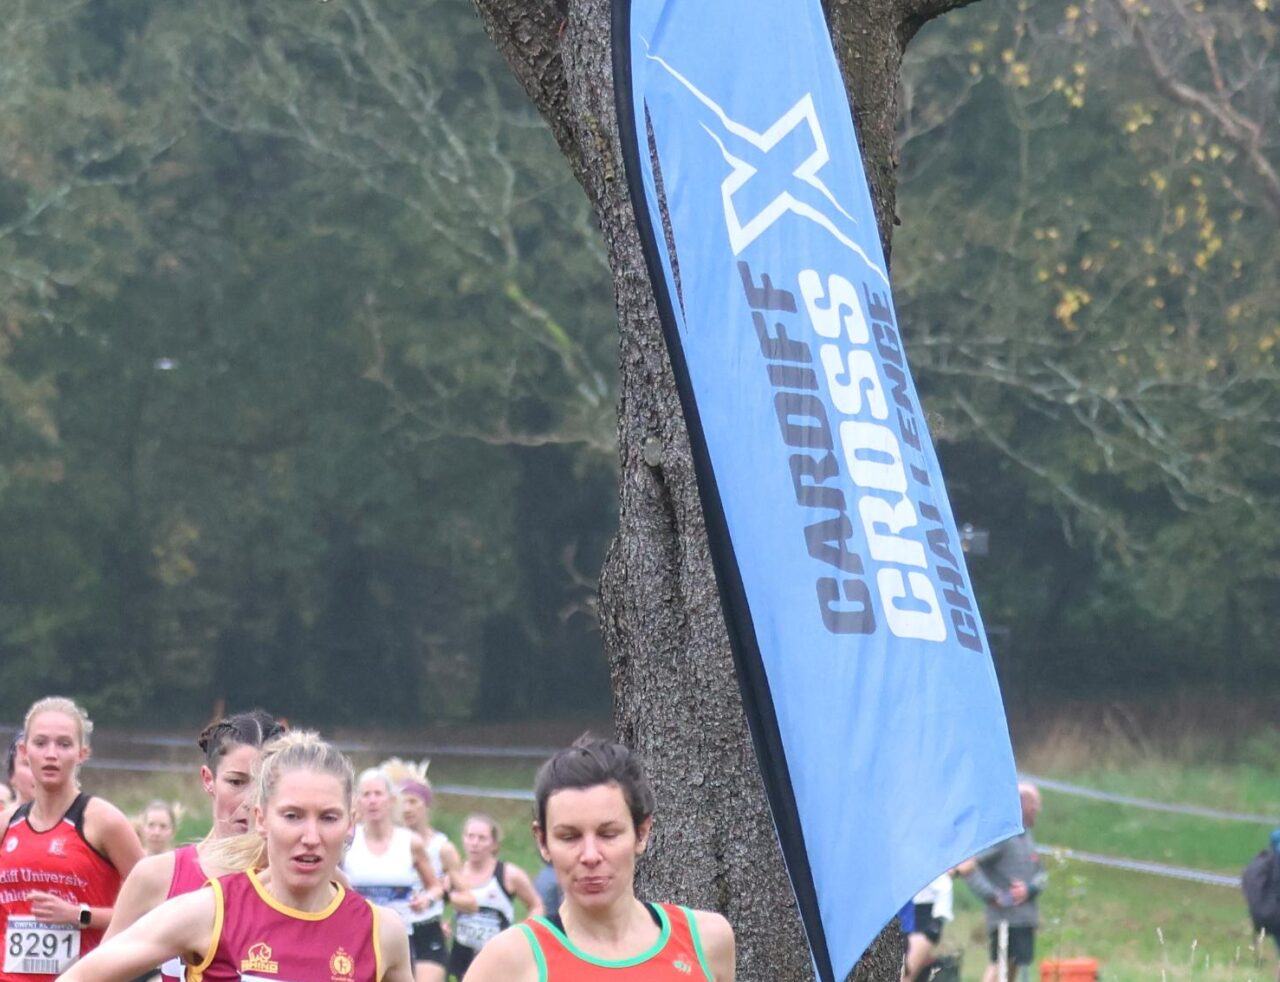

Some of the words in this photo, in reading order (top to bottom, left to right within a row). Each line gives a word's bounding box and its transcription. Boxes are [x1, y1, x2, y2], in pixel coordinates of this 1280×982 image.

[737, 260, 877, 635] CARDIFF
[798, 269, 947, 642] CROSS
[9, 932, 73, 959] 8291
